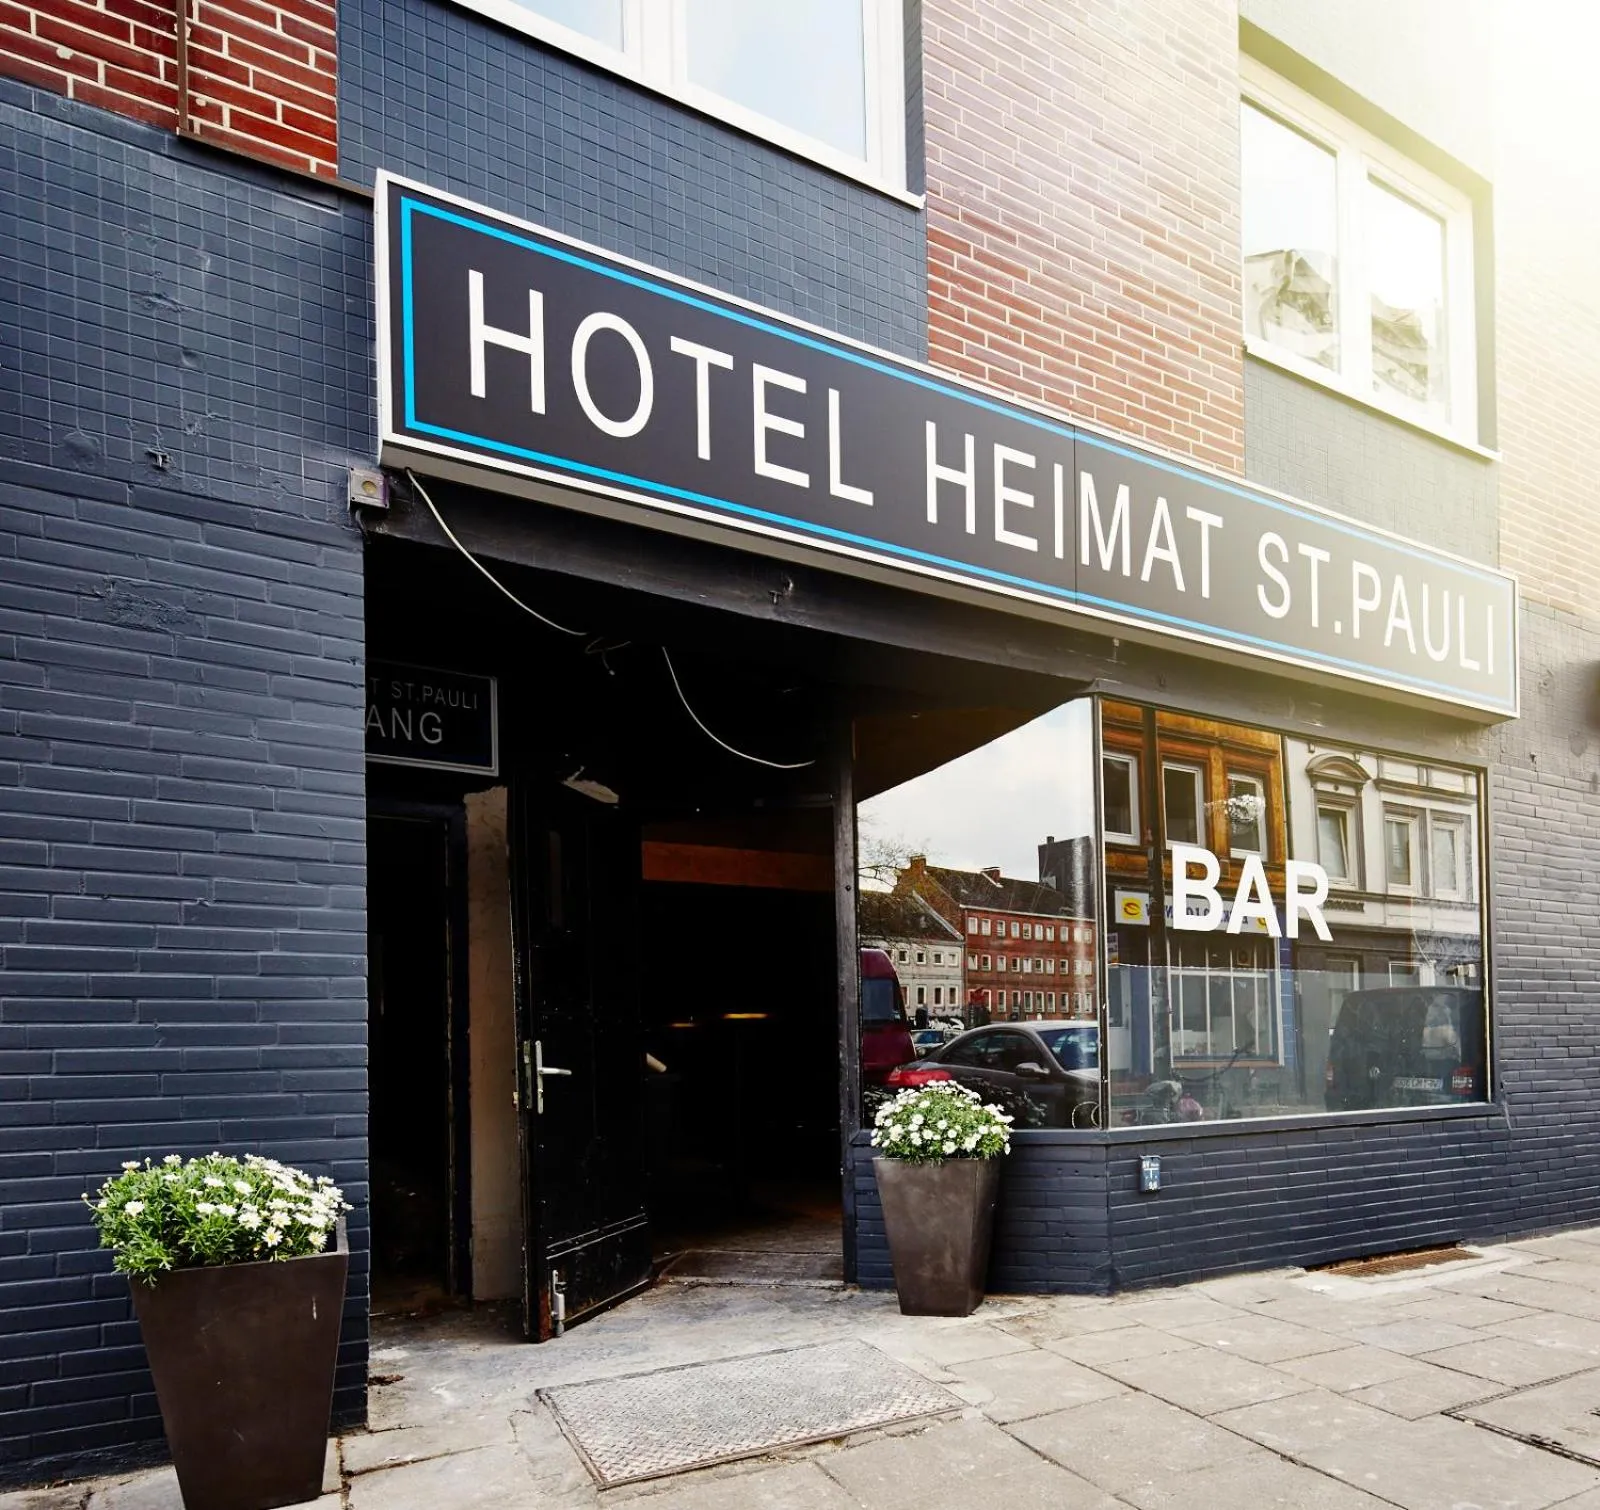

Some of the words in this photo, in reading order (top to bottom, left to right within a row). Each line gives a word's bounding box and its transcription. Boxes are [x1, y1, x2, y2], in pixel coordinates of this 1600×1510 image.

[469, 269, 874, 506] HOTEL
[926, 420, 1223, 599] HEIMAT
[1257, 532, 1494, 674] ST.PAULI
[391, 681, 478, 710] ST.PAULI
[1172, 845, 1334, 941] BAR
